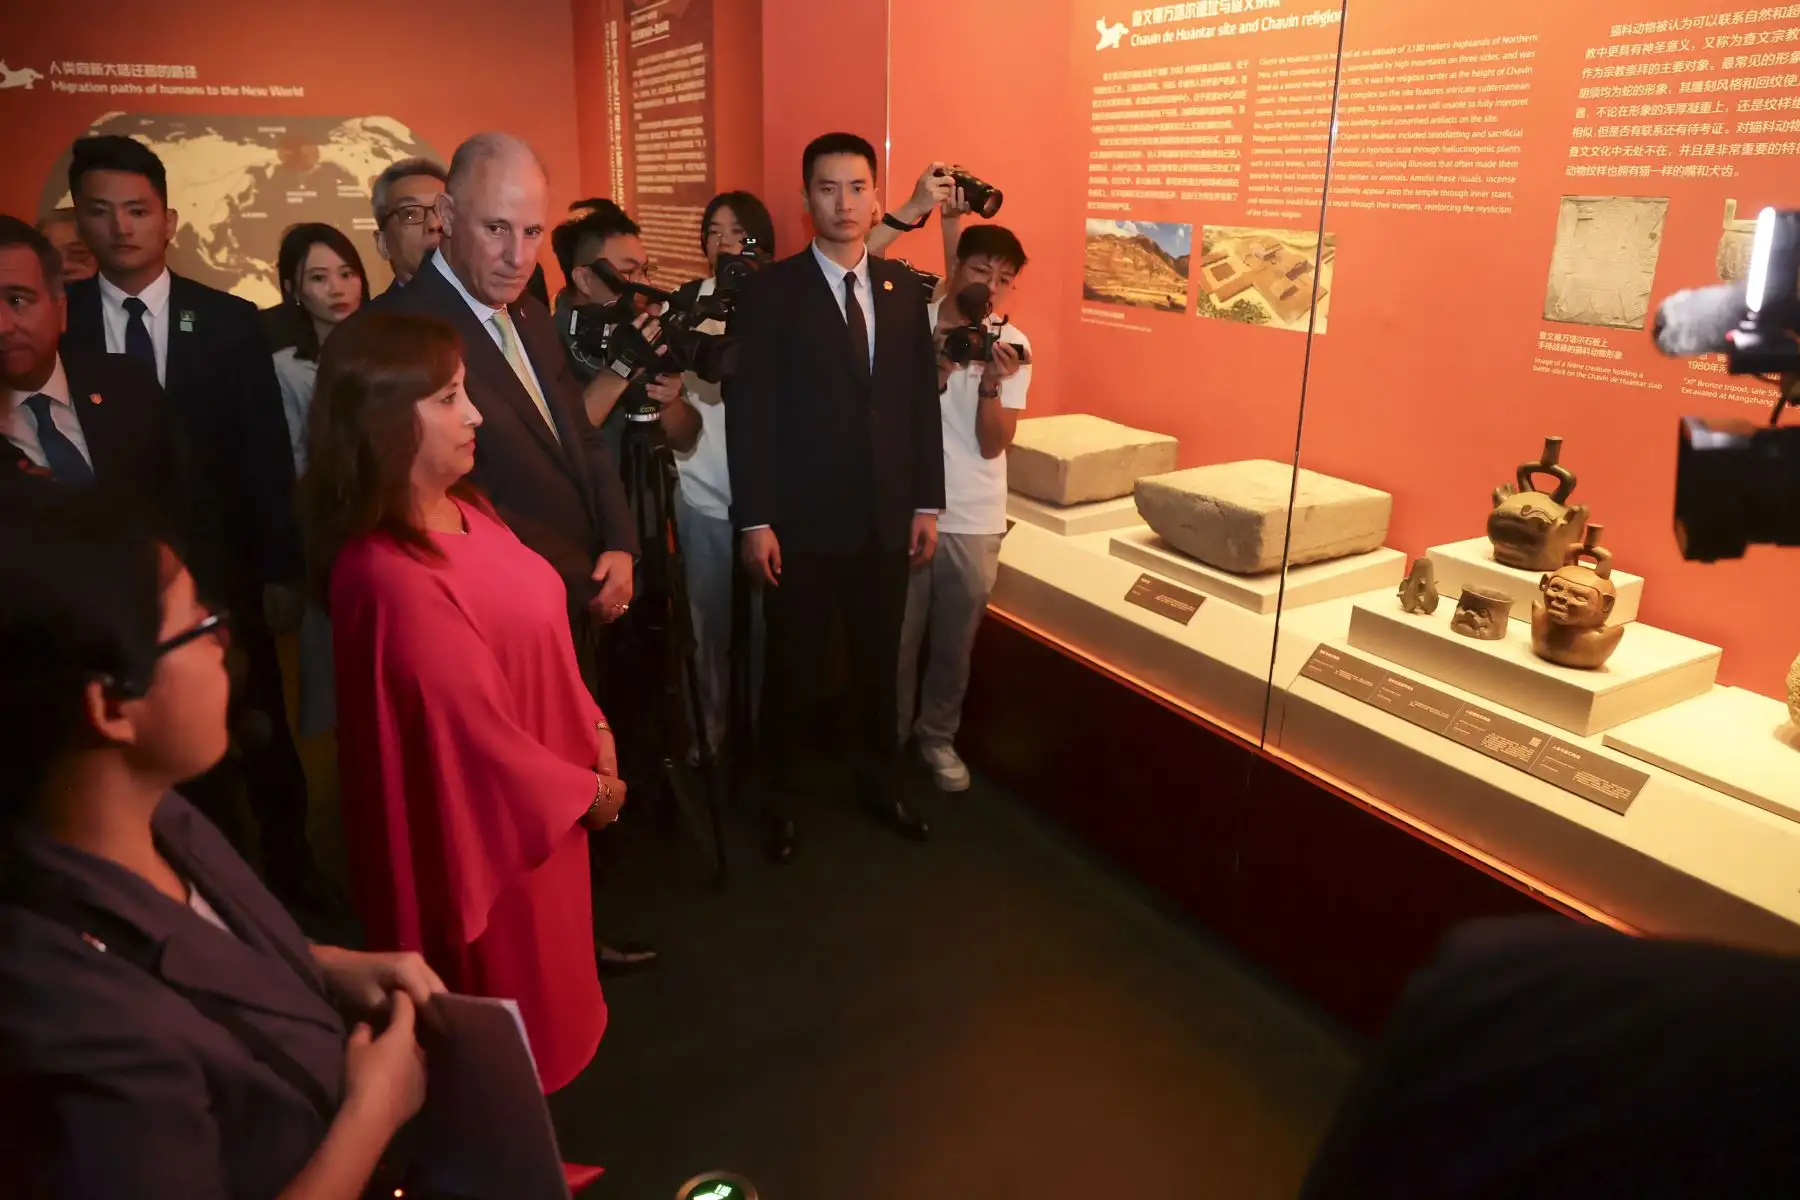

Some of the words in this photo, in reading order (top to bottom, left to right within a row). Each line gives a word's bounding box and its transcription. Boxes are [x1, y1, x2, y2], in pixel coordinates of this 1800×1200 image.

[1162, 31, 1174, 43] de
[1218, 22, 1237, 36] site
[1239, 18, 1259, 33] and
[1492, 36, 1501, 45] of
[1502, 34, 1538, 44] Northern
[1394, 60, 1410, 69] high
[1411, 58, 1446, 67] mountains
[1459, 54, 1478, 63] three
[1502, 50, 1518, 60] and
[1520, 50, 1535, 58] was
[1458, 70, 1470, 78] the
[1472, 67, 1495, 78] height
[1496, 66, 1506, 76] of
[51, 80, 108, 94] Migration
[110, 84, 142, 95] paths
[145, 84, 156, 94] of
[160, 84, 205, 95] humans
[206, 86, 219, 96] to
[220, 85, 240, 96] the
[241, 85, 268, 97] New
[269, 85, 304, 97] World
[1416, 87, 1444, 96] features
[1446, 85, 1477, 94] intricate
[1478, 82, 1530, 92] subterranean
[1478, 100, 1494, 110] fully
[1495, 98, 1529, 107] interpret
[1470, 114, 1482, 122] the
[1398, 131, 1426, 139] included
[1472, 130, 1486, 138] and
[1488, 128, 1524, 138] sacrificial
[1413, 145, 1440, 155] through
[1496, 144, 1521, 154] plants
[1408, 160, 1437, 168] illusions
[1438, 160, 1454, 168] that
[1454, 160, 1473, 168] often
[1475, 160, 1496, 168] made
[1498, 160, 1518, 168] them
[1566, 164, 1740, 178] 动物纹样也拥有猫一样的嘴和犬齿。
[1436, 174, 1456, 182] these
[1486, 175, 1516, 184] incense
[1403, 188, 1414, 196] the
[1415, 188, 1440, 198] temple
[1440, 188, 1468, 198] through
[1470, 190, 1489, 198] inner
[1424, 202, 1460, 213] reinforcing
[1462, 204, 1474, 212] the
[1475, 204, 1512, 214] mysticism
[1534, 358, 1554, 366] Image
[1585, 364, 1612, 374] creature
[1612, 368, 1638, 379] holding
[1576, 370, 1587, 379] the
[1648, 382, 1662, 390] slab
[1698, 380, 1724, 389] Bronze
[1724, 384, 1749, 394] tripod,
[1752, 387, 1767, 396] late
[1681, 387, 1718, 398] Excavated
[1719, 392, 1727, 400] at
[1728, 395, 1774, 408] Mangzhang
